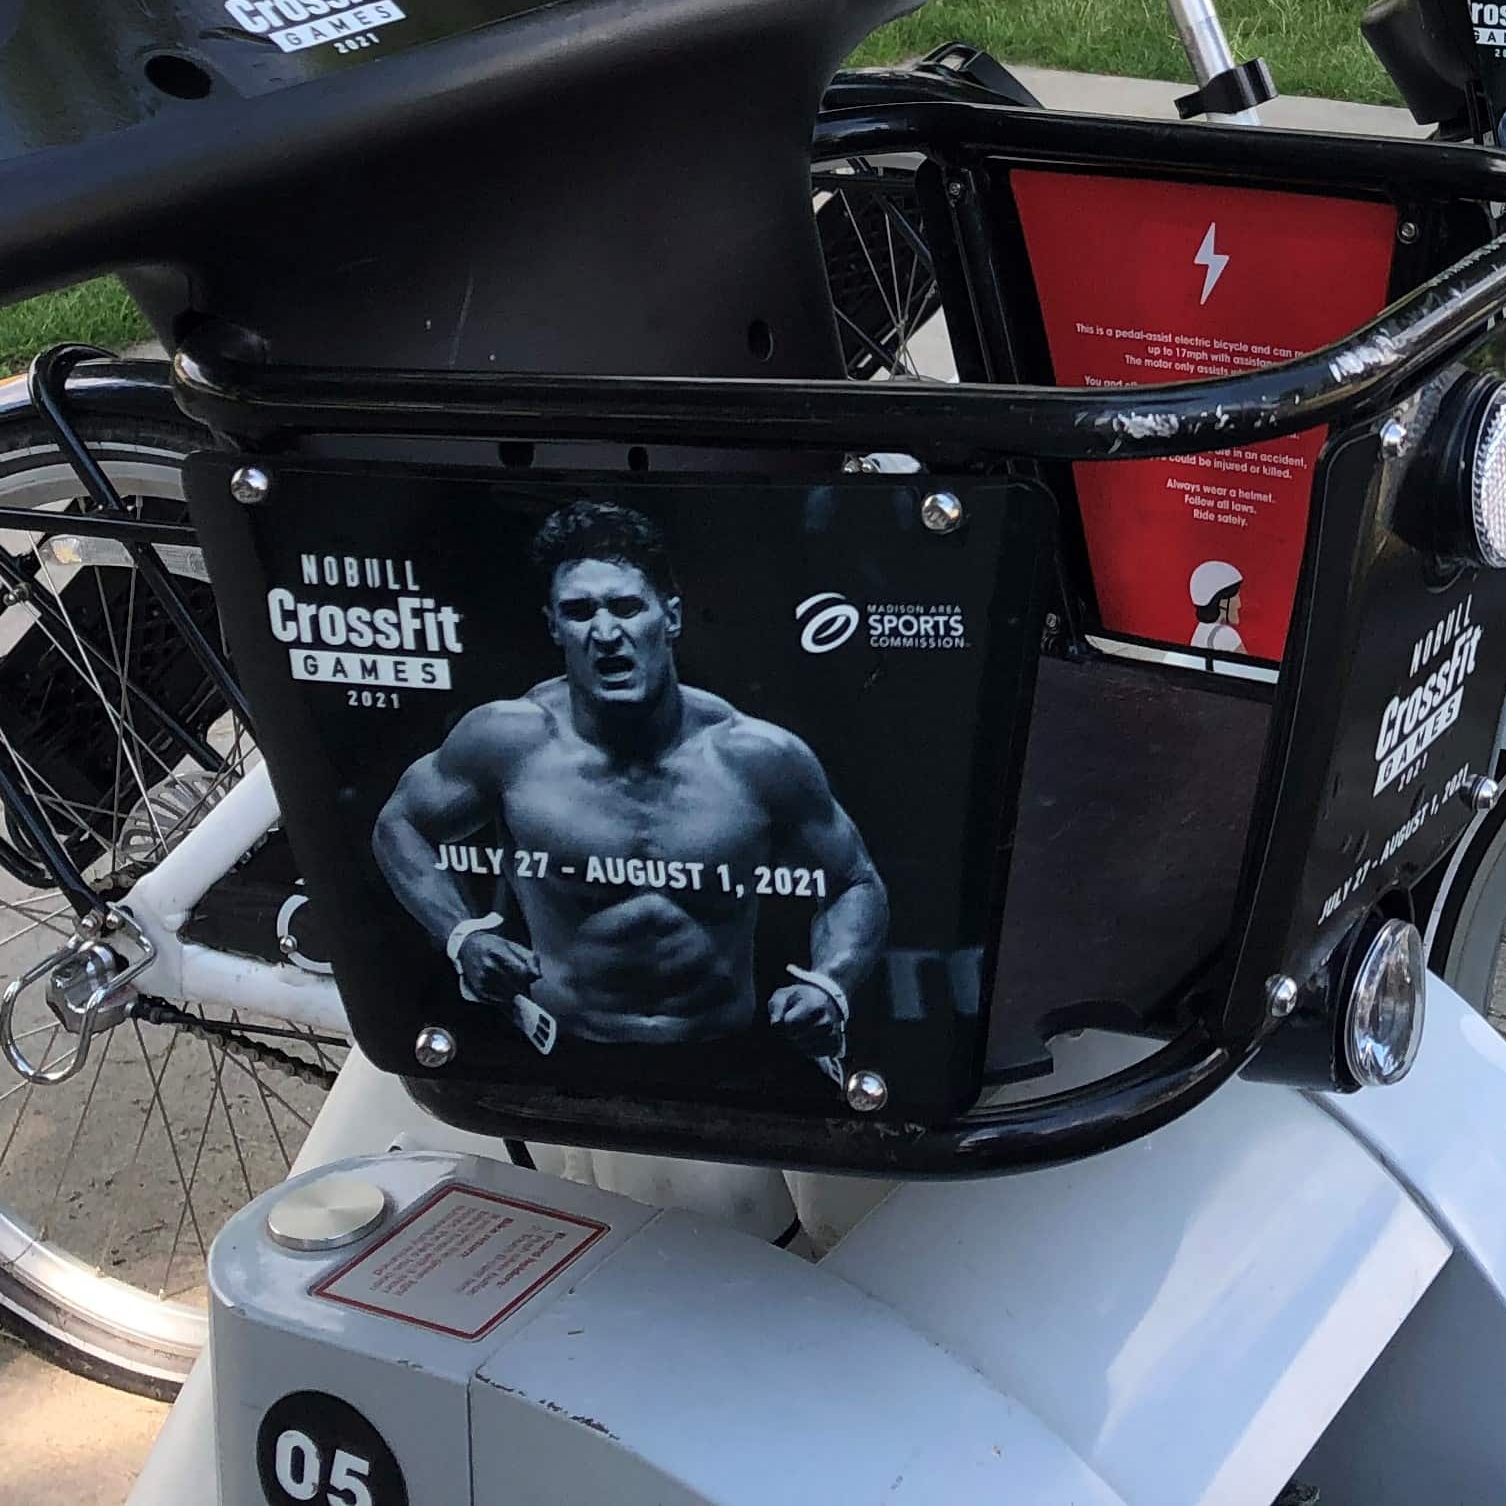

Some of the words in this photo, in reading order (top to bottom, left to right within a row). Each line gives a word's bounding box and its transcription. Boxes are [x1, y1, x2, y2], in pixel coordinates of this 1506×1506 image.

[285, 5, 393, 45] GAMES
[333, 32, 380, 54] 2021
[1076, 323, 1094, 335] This
[1096, 324, 1104, 335] is
[1106, 328, 1113, 337] a
[1115, 328, 1172, 343] pedal-assist
[1174, 335, 1211, 348] electric
[1213, 338, 1249, 353] bicycle
[1251, 343, 1271, 356] and
[1273, 347, 1292, 358] can
[1125, 354, 1142, 366] The
[1144, 358, 1173, 370] motor
[1174, 361, 1195, 374] only
[1147, 345, 1161, 357] up
[1163, 346, 1173, 357] to
[1175, 347, 1208, 362] 17mph
[1210, 351, 1231, 364] with
[1084, 375, 1102, 387] You
[1169, 453, 1196, 465] could
[1199, 456, 1212, 468] be
[1213, 458, 1248, 473] injured
[1249, 464, 1261, 474] or
[1262, 465, 1293, 479] killed.
[1233, 447, 1243, 459] in
[1245, 451, 1258, 461] an
[1259, 452, 1308, 470] accident,
[1166, 477, 1200, 493] Always
[1202, 484, 1228, 496] wear
[1229, 487, 1237, 497] a
[1238, 489, 1277, 504] helmet.
[1184, 494, 1215, 508] Follow
[1217, 497, 1230, 510] all
[1231, 499, 1257, 515] laws.
[1193, 508, 1215, 522] Ride
[1217, 513, 1249, 527] safely.
[301, 554, 420, 591] NOBULL
[268, 588, 464, 653] CrossFit
[867, 604, 924, 614] MADISON
[928, 604, 962, 614] AREA
[868, 615, 964, 636] SPORTS
[1410, 594, 1472, 678] NOBULL
[870, 637, 965, 649] COMMISSION
[303, 655, 437, 684] GAMES
[347, 690, 400, 709] 2021
[1375, 624, 1484, 761] CrossFit
[1383, 697, 1457, 780] GAMES
[1398, 751, 1429, 793] 2021
[434, 844, 503, 875] JULY
[514, 850, 548, 878] 27
[585, 856, 704, 891] AUGUST
[716, 863, 744, 898] 1,
[754, 866, 827, 897] 2021
[1317, 878, 1352, 926] JULY
[1352, 859, 1371, 893] 27
[1380, 800, 1430, 868] AUGUST
[275, 1429, 373, 1506] 05
